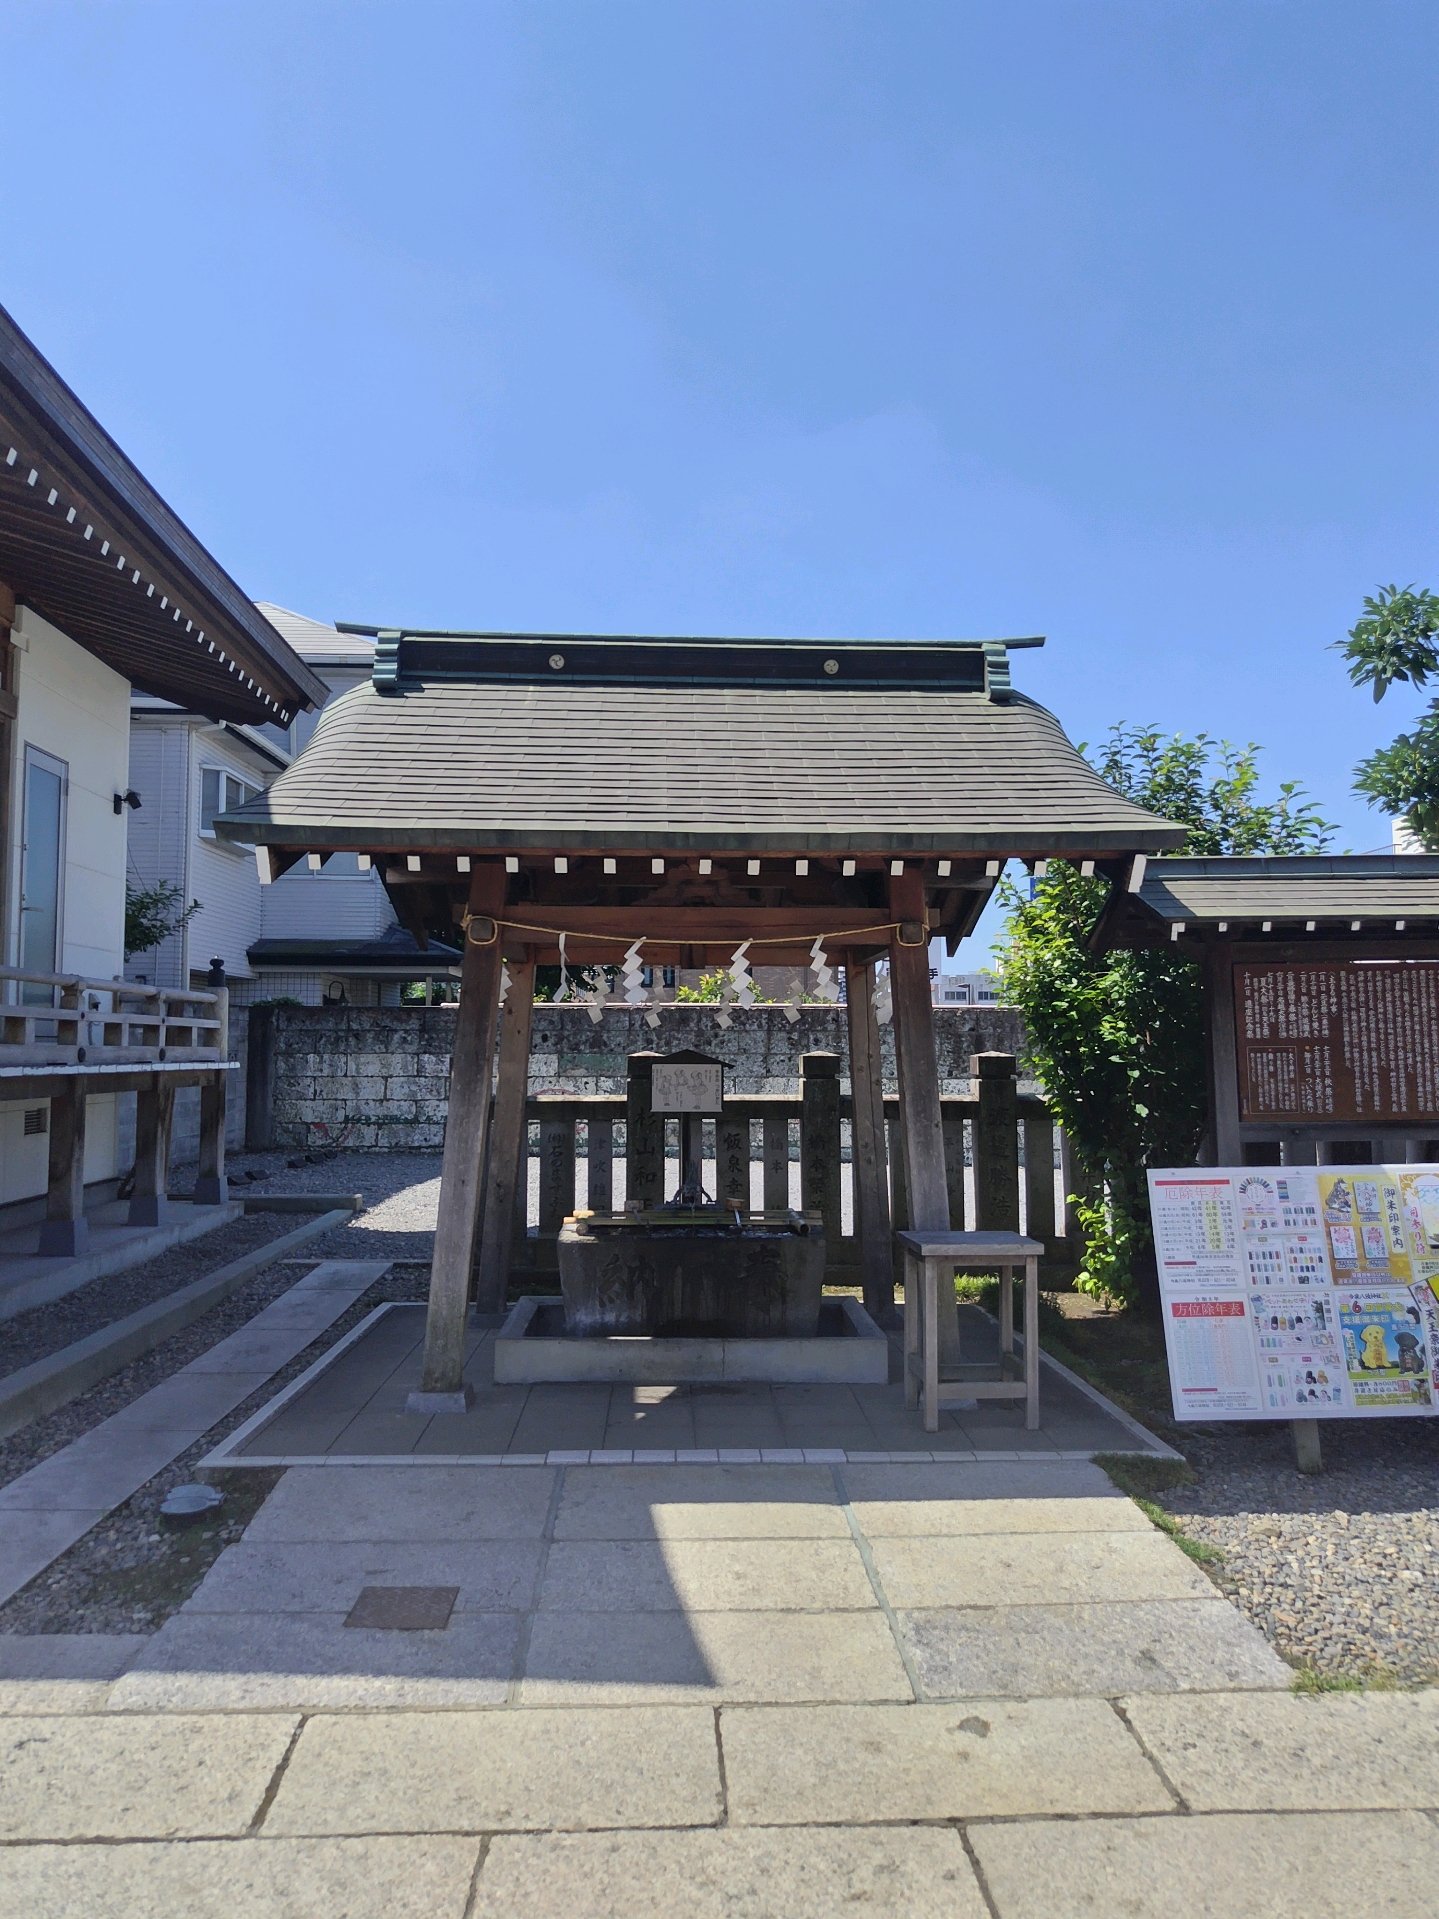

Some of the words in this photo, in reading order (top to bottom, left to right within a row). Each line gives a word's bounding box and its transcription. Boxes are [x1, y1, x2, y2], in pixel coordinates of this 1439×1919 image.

[1164, 1186, 1223, 1200] 厄除年表
[1383, 1187, 1405, 1249] 御朱印案内
[1175, 1302, 1241, 1316] 方位除年表
